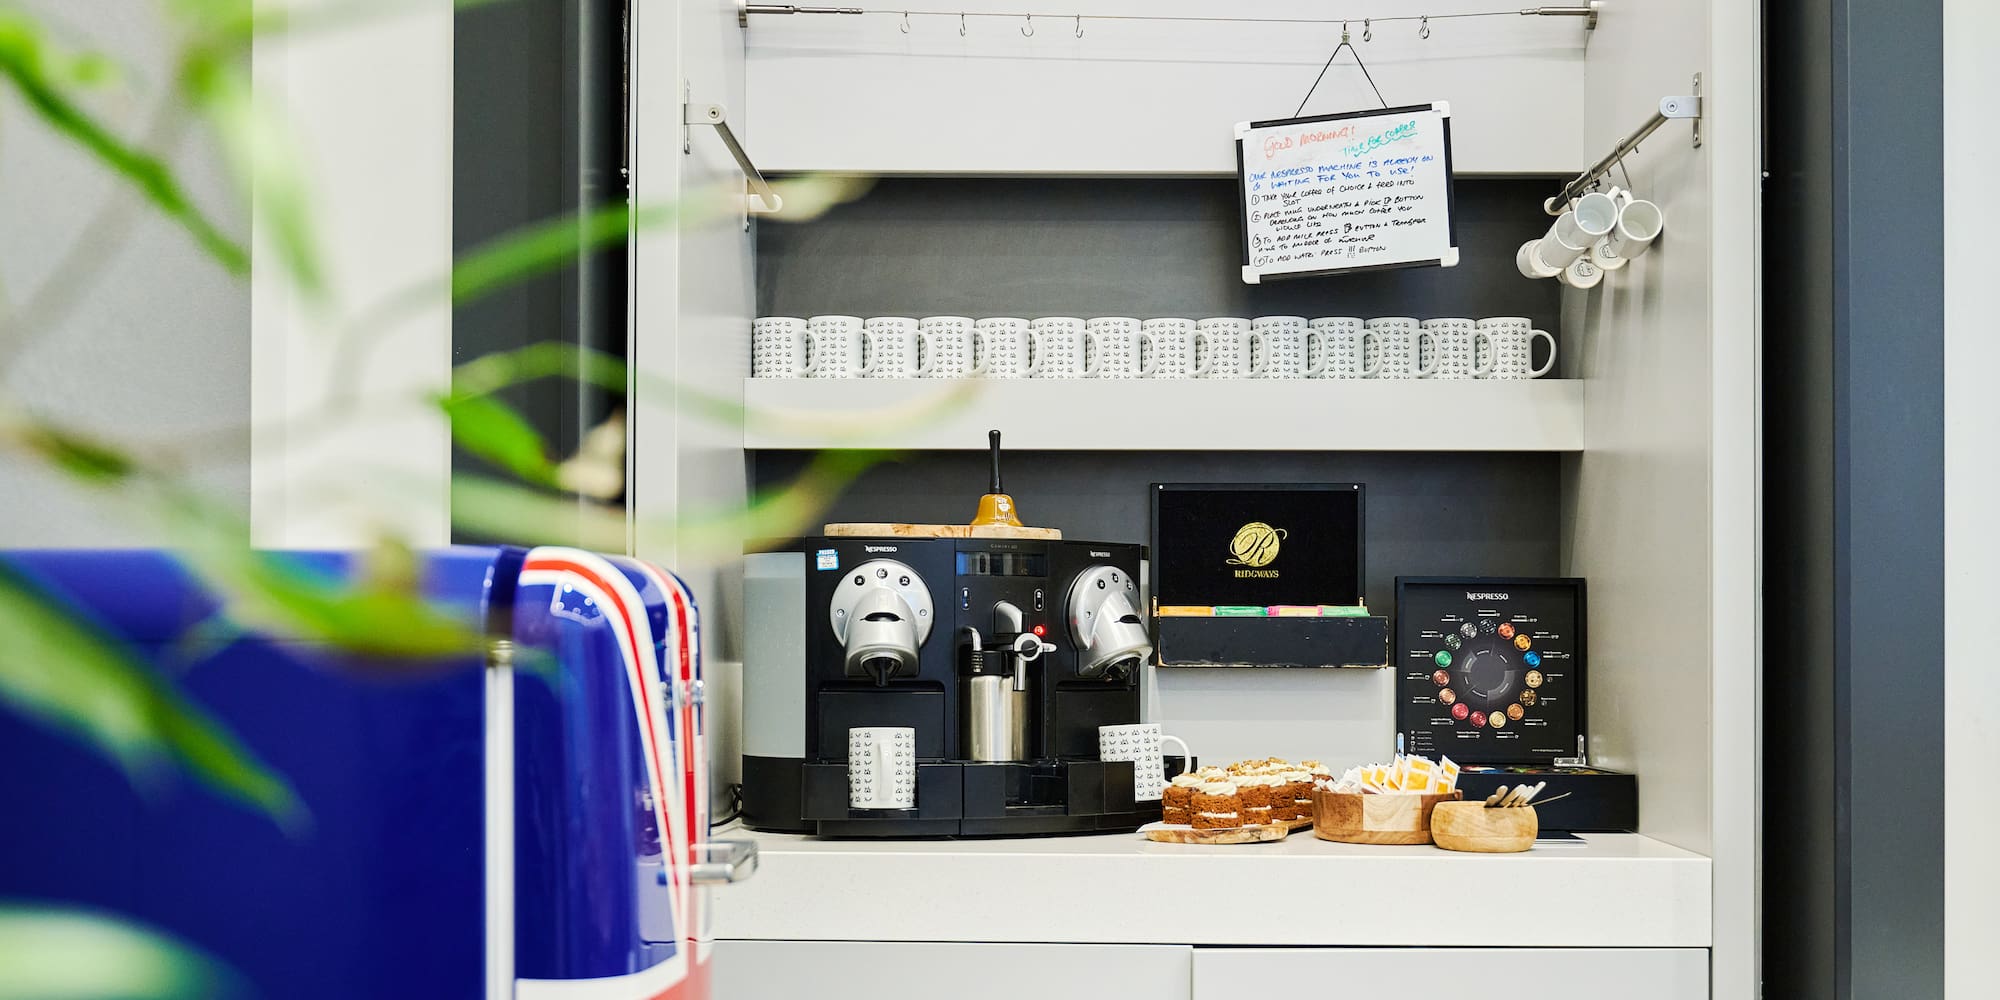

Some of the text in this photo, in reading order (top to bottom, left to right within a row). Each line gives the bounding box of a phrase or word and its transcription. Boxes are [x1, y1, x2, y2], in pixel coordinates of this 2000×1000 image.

[1367, 135, 1382, 146] FOR
[1384, 120, 1416, 138] COFFEE
[1270, 166, 1314, 180] NESPRESSO
[1318, 161, 1362, 173] MACHINE
[1368, 160, 1378, 168] IS
[1270, 177, 1310, 189] WAITING
[1317, 174, 1336, 183] FOR
[1341, 171, 1361, 180] YOU
[1366, 170, 1381, 178] TO
[1280, 191, 1297, 200] YOUR
[1339, 183, 1365, 193] CHOICE
[1283, 199, 1301, 207] SLOT
[1394, 195, 1424, 204] BUTTON
[1276, 234, 1291, 242] ADD
[1316, 228, 1339, 237] PRESS
[1277, 254, 1291, 262] ADD
[864, 545, 898, 553] NESPRESSO
[1234, 569, 1280, 578] RIDGWAYS
[1466, 591, 1509, 601] NESPRESSO
